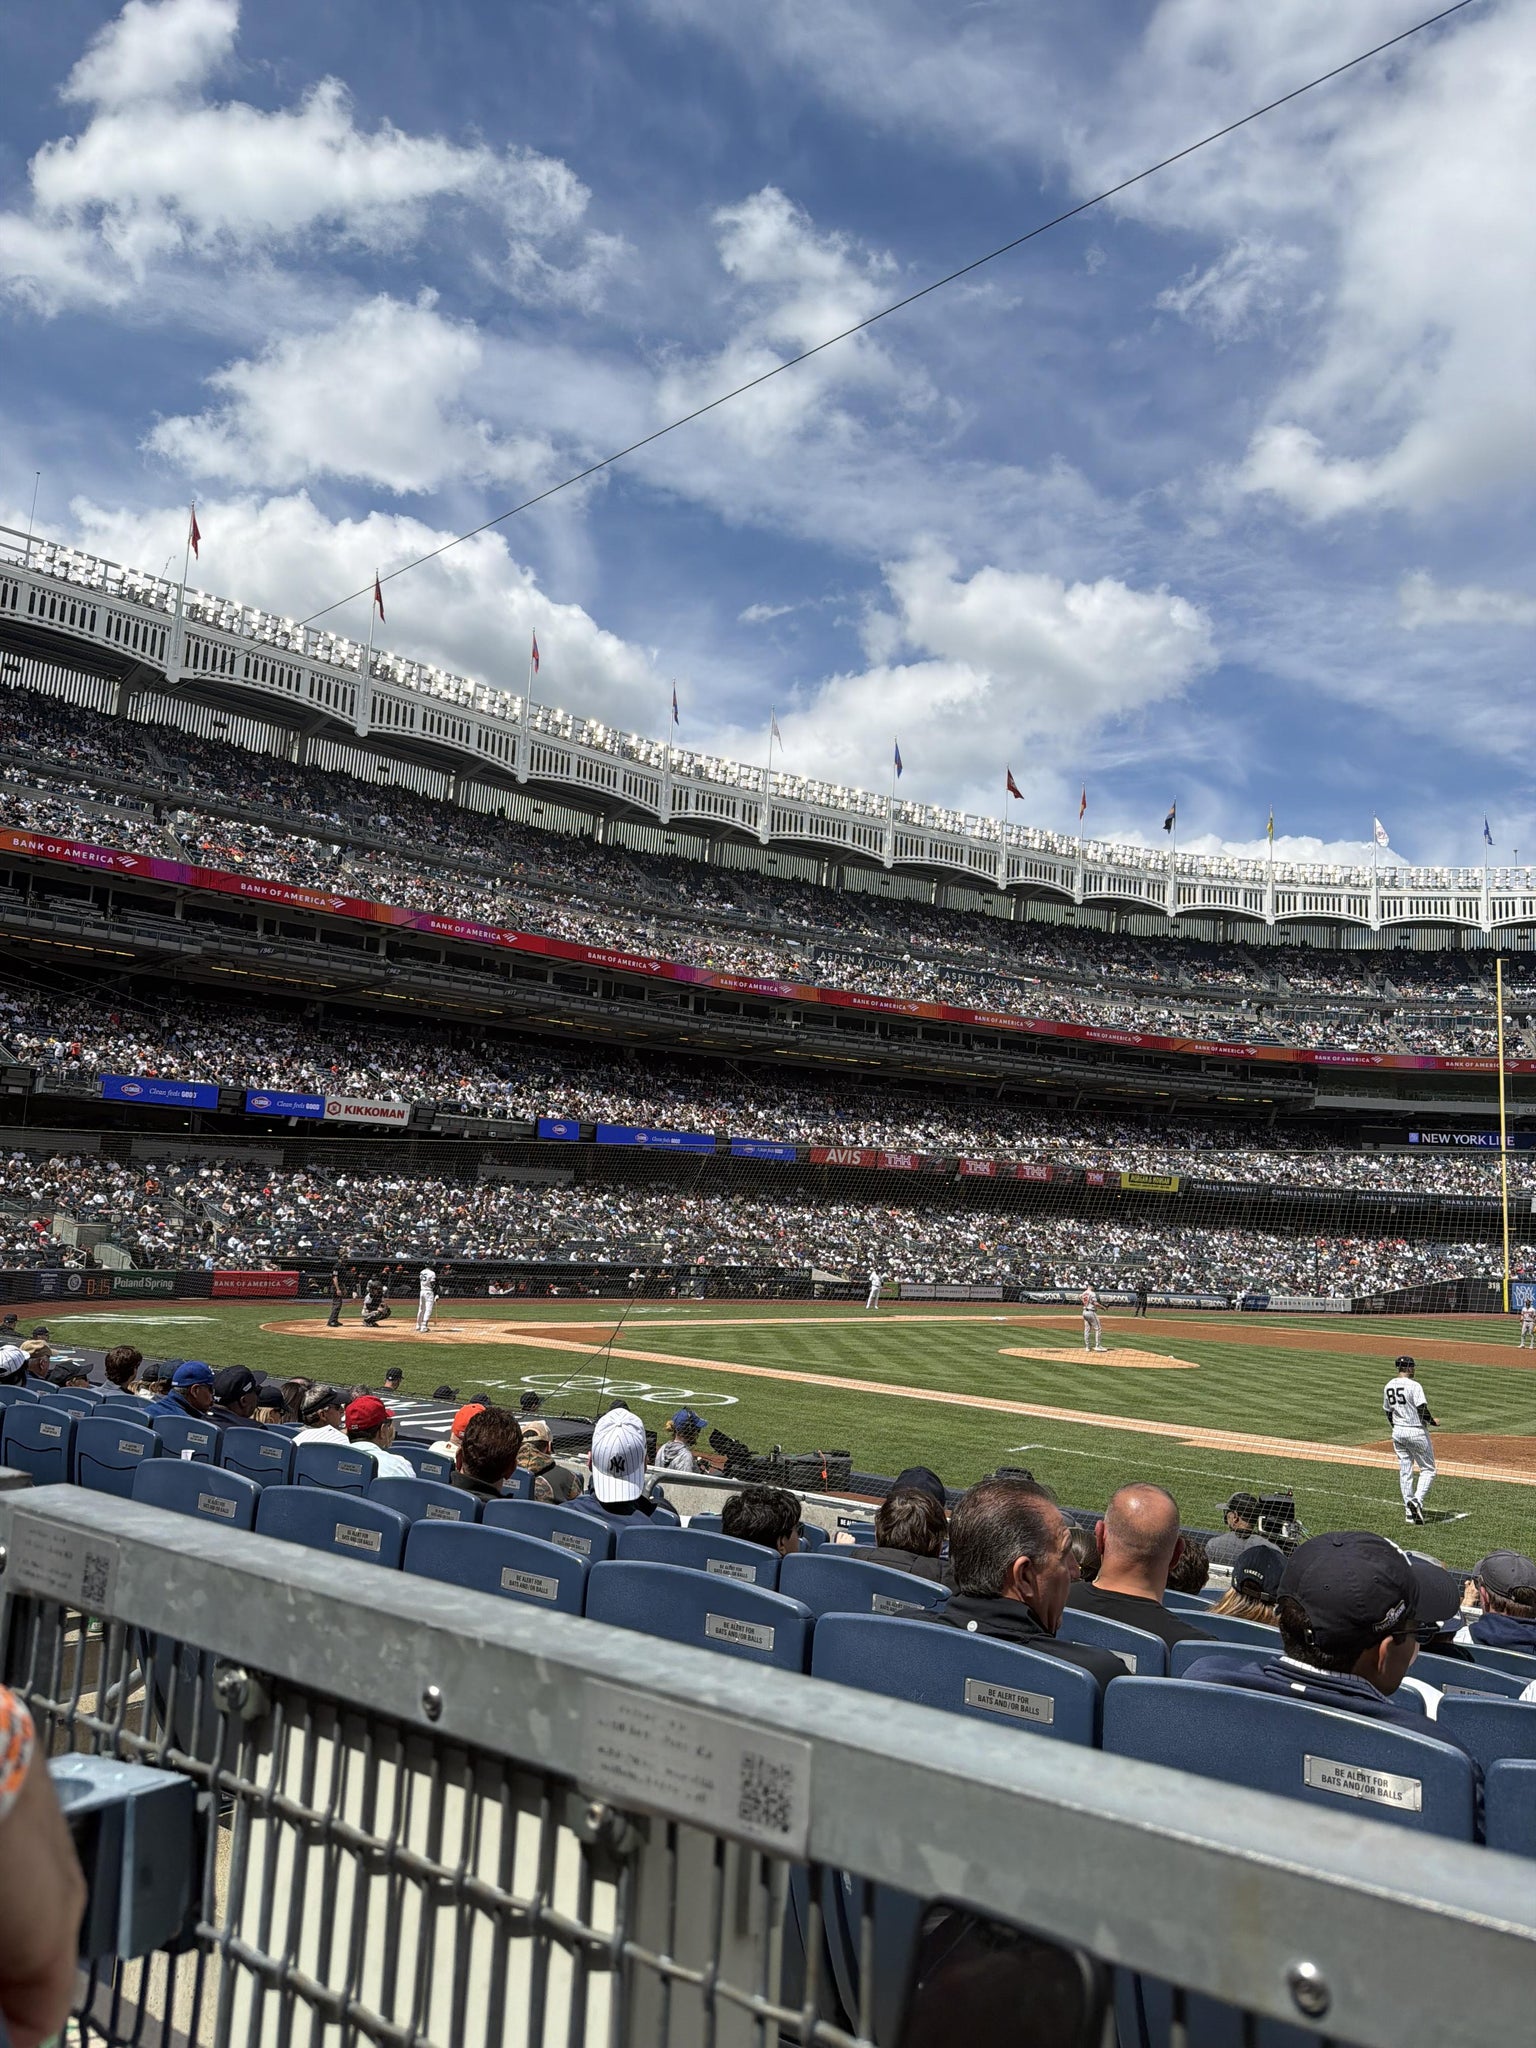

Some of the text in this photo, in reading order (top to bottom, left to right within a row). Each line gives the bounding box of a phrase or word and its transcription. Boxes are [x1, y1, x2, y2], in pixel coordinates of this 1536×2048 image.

[13, 838, 114, 864] BANK OF AMERICA
[240, 883, 267, 894] BANK
[284, 892, 326, 906] AMERICA
[430, 921, 453, 930] BANK
[466, 928, 501, 940] AMERICA
[588, 952, 606, 960] BANK
[618, 958, 647, 968] AMERICA
[820, 951, 900, 971] ASPEN VODKA
[749, 983, 778, 992] AMERICA
[944, 972, 1019, 988] ASPEN VODKA
[880, 1002, 906, 1010] AMERICA
[999, 1018, 1023, 1027] AMERICA
[149, 1088, 166, 1096] Clean
[344, 1105, 405, 1119] KIKKOMAN
[1422, 1134, 1515, 1146] NEW YORK LIE
[826, 1148, 861, 1165] AVIS
[885, 1154, 912, 1165] THK
[114, 1277, 173, 1290] Poland Spring
[1516, 1286, 1533, 1295] NEW
[1386, 1387, 1406, 1405] 85
[610, 1454, 625, 1473] NY
[748, 1635, 762, 1644] BALLS
[988, 1689, 1029, 1704] BE ALERT FOR
[978, 1695, 1039, 1715] BATS AND/OR BALLS
[1335, 1768, 1388, 1787] BE ALERT FOR
[1322, 1775, 1403, 1800] BATS AND/OR BALLS
